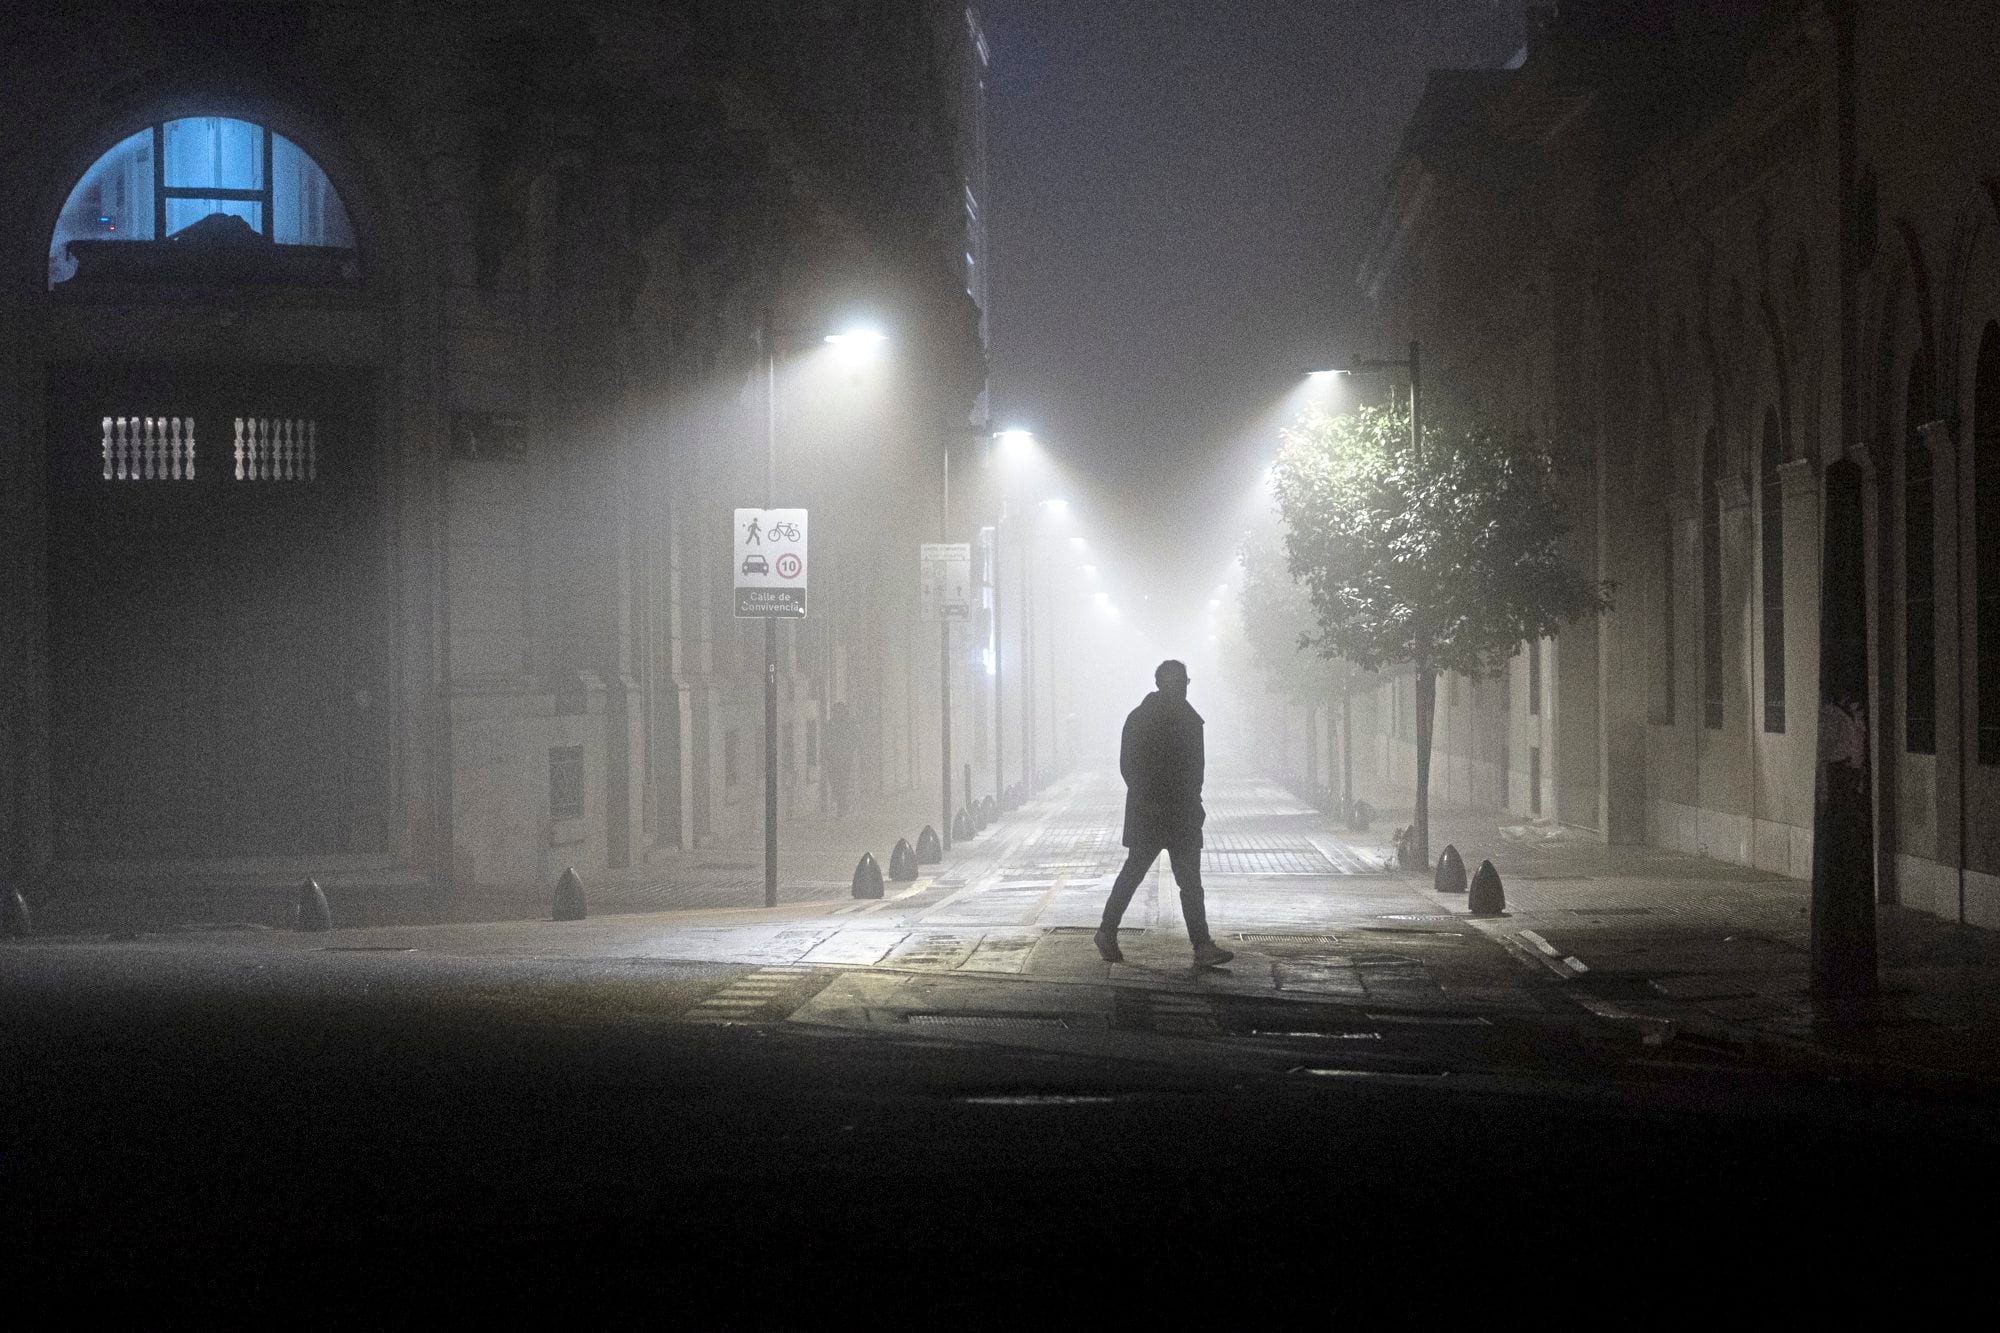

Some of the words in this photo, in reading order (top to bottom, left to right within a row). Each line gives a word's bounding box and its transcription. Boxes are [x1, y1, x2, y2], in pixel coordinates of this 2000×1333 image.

[782, 560, 796, 572] 10
[750, 592, 776, 601] Calle
[778, 592, 791, 601] de
[741, 602, 799, 611] Convivencia
